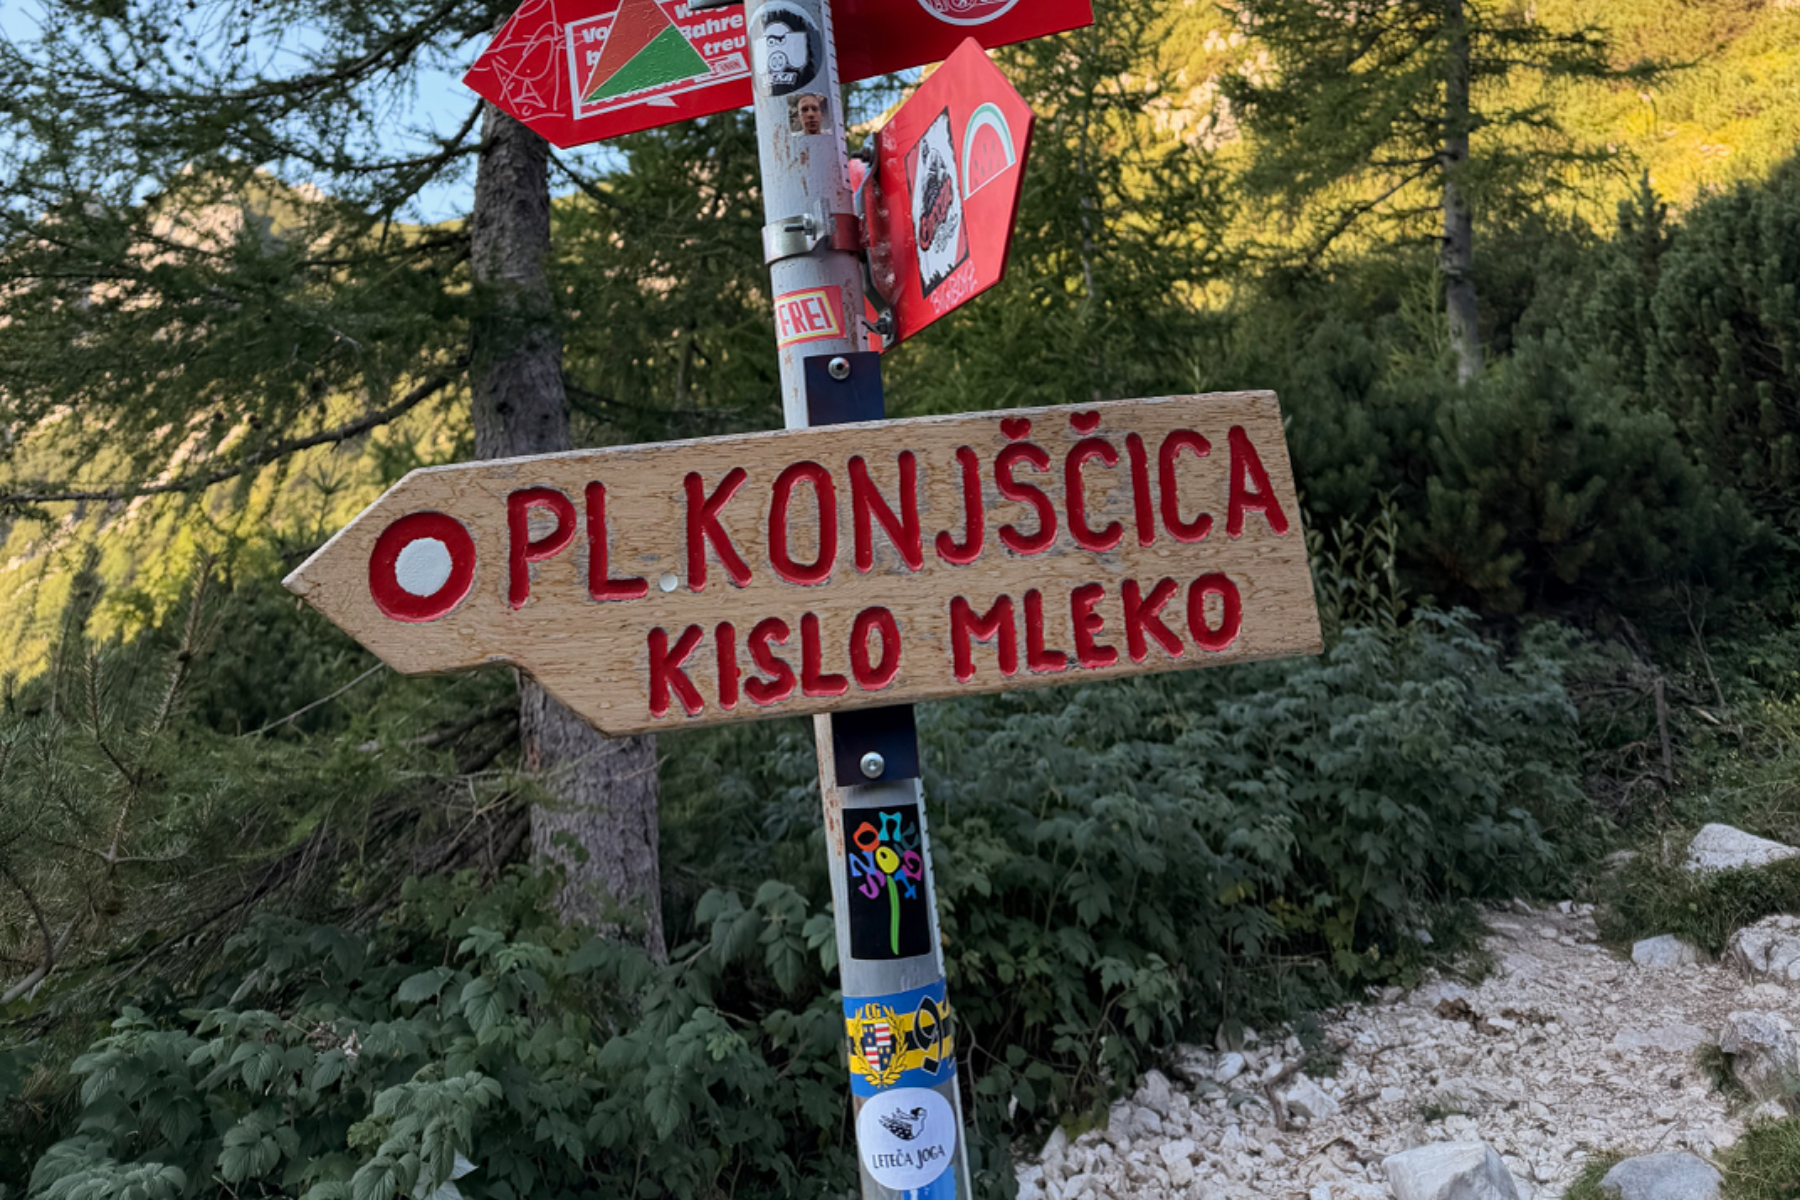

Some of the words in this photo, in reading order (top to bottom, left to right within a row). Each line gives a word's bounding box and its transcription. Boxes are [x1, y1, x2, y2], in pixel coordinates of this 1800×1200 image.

[703, 35, 746, 57] treu
[777, 296, 833, 337] FREI
[684, 410, 1289, 594] KONJŠČICA
[647, 604, 903, 718] KISLO
[950, 570, 1243, 683] MLEKO
[871, 1149, 914, 1170] LETEČA
[916, 1144, 946, 1170] JOGA
